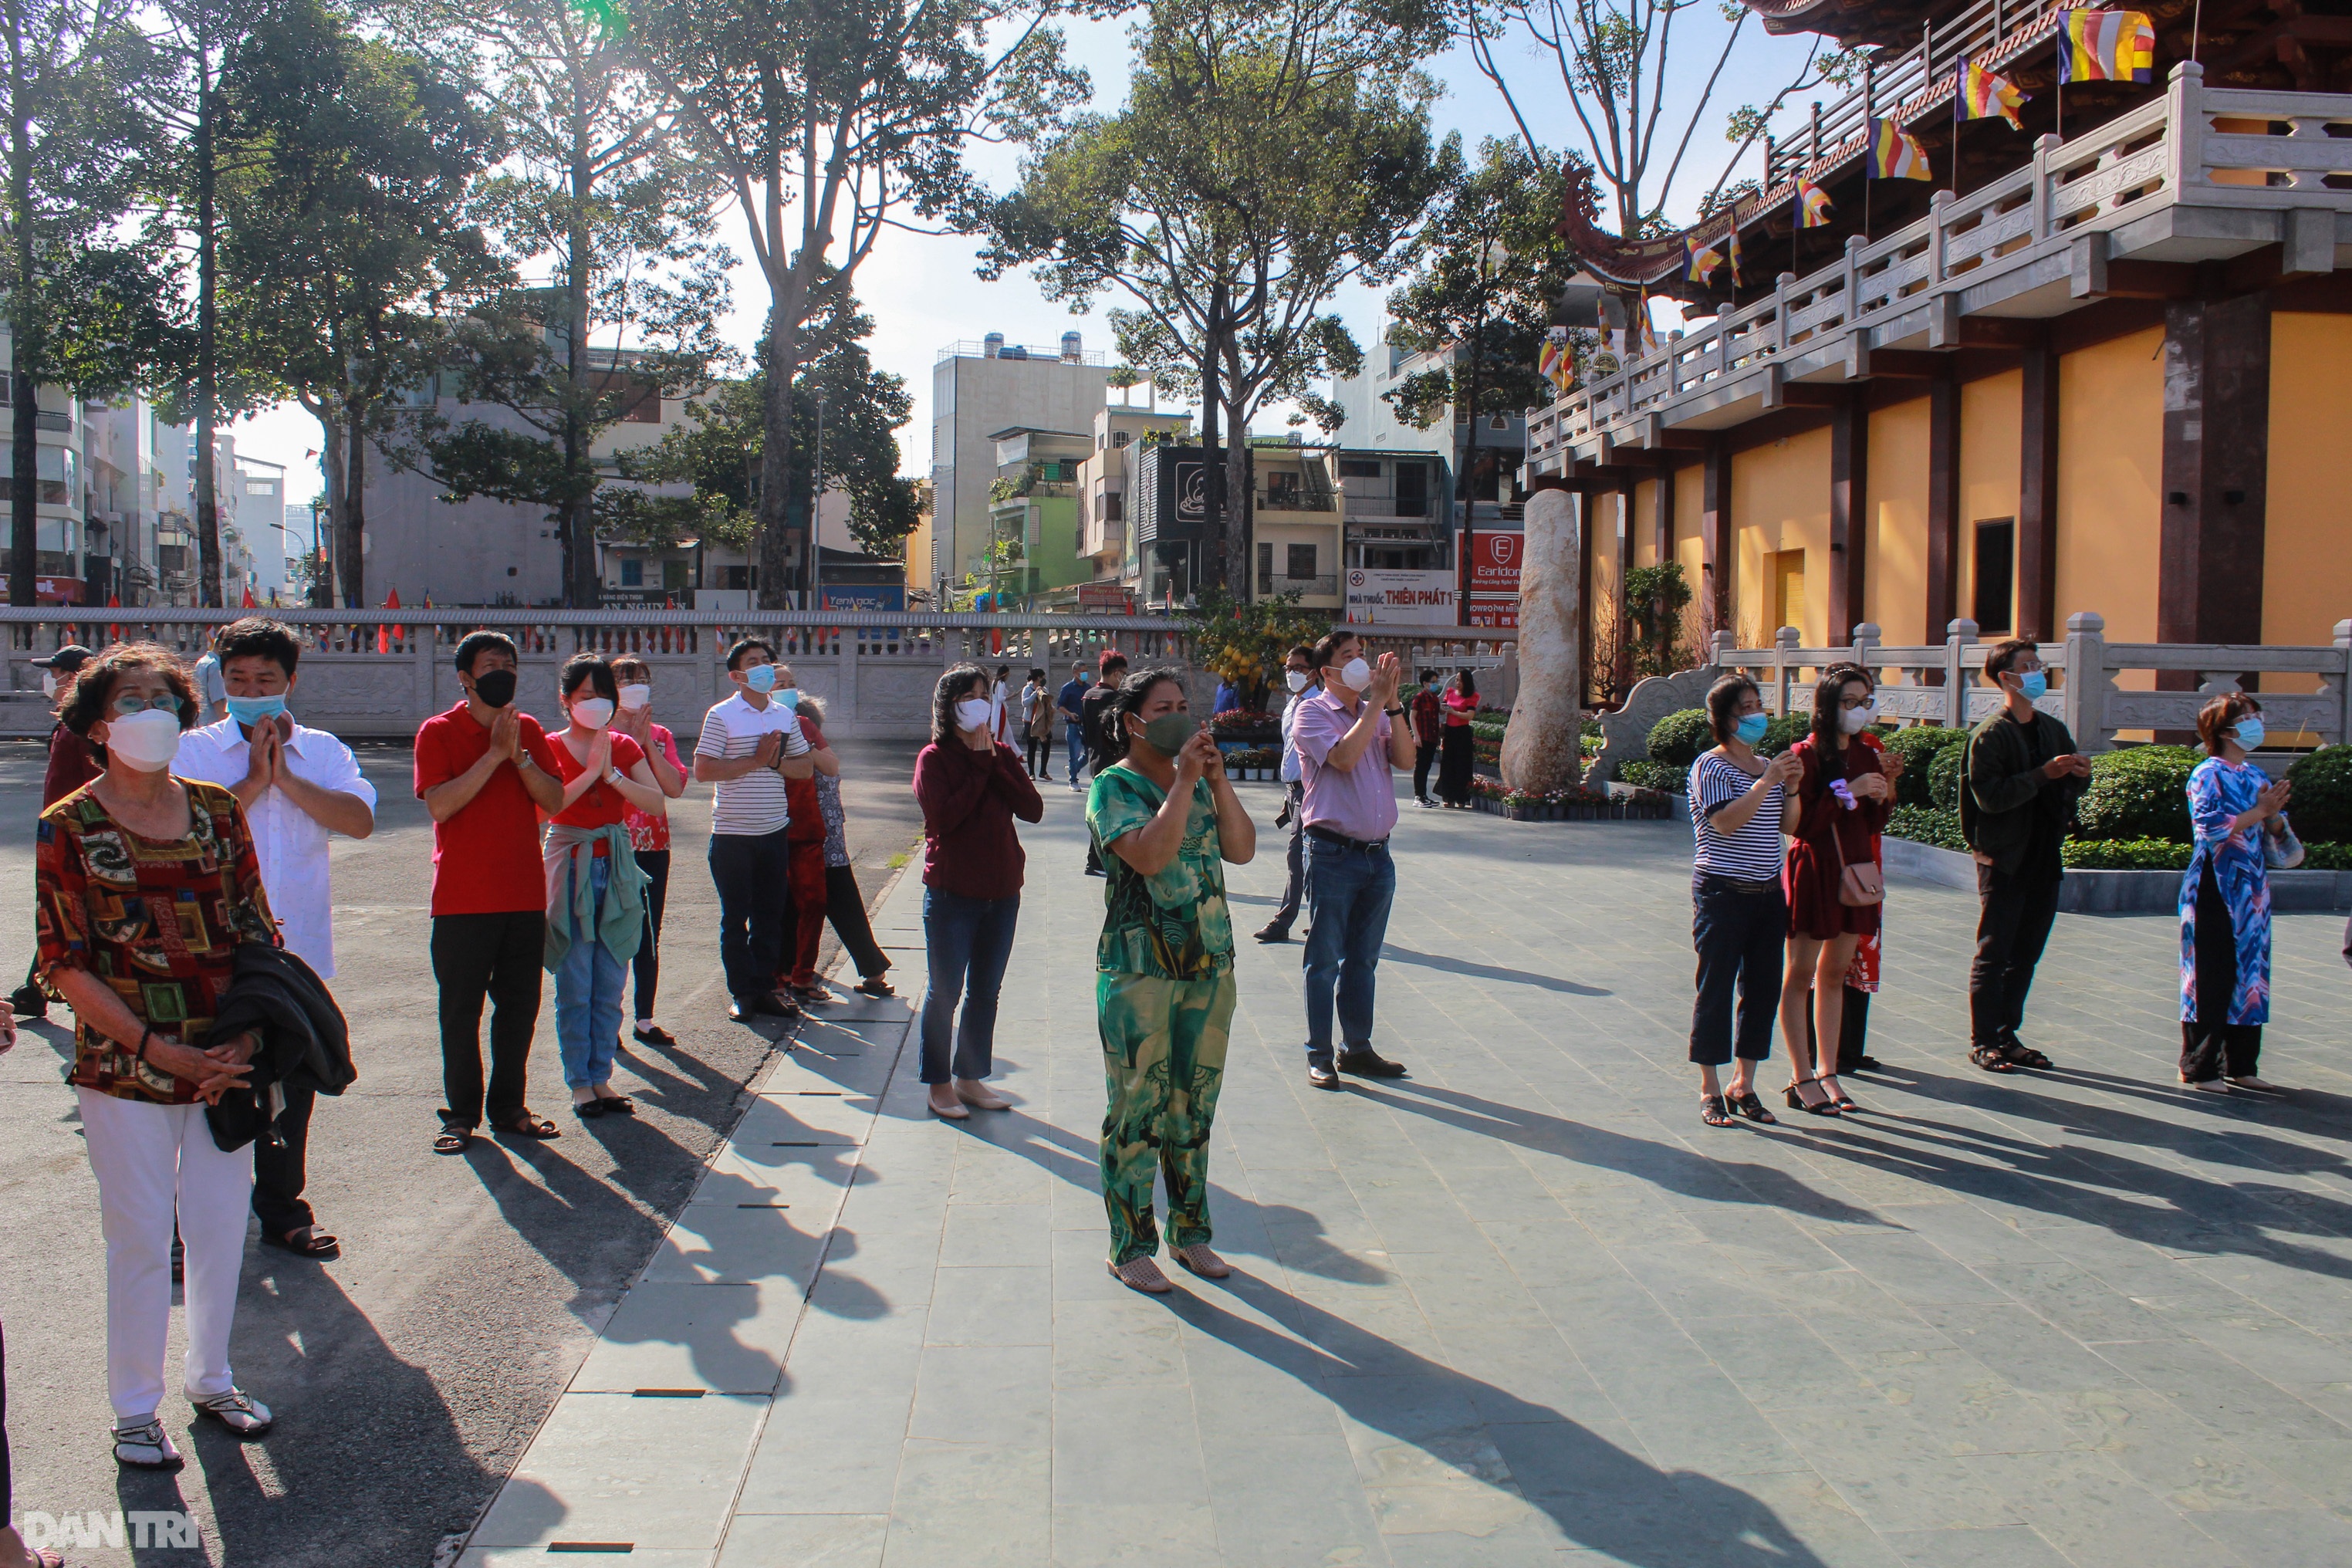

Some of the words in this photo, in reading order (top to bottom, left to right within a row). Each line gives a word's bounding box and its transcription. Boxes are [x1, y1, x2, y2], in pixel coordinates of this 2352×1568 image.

[1349, 593, 1362, 604] NHÀ
[1363, 592, 1384, 605] THUỐC
[1385, 587, 1416, 605] THIÊN
[1418, 587, 1446, 606] PHÁT
[1447, 591, 1453, 606] 1
[626, 599, 686, 610] NGUYN
